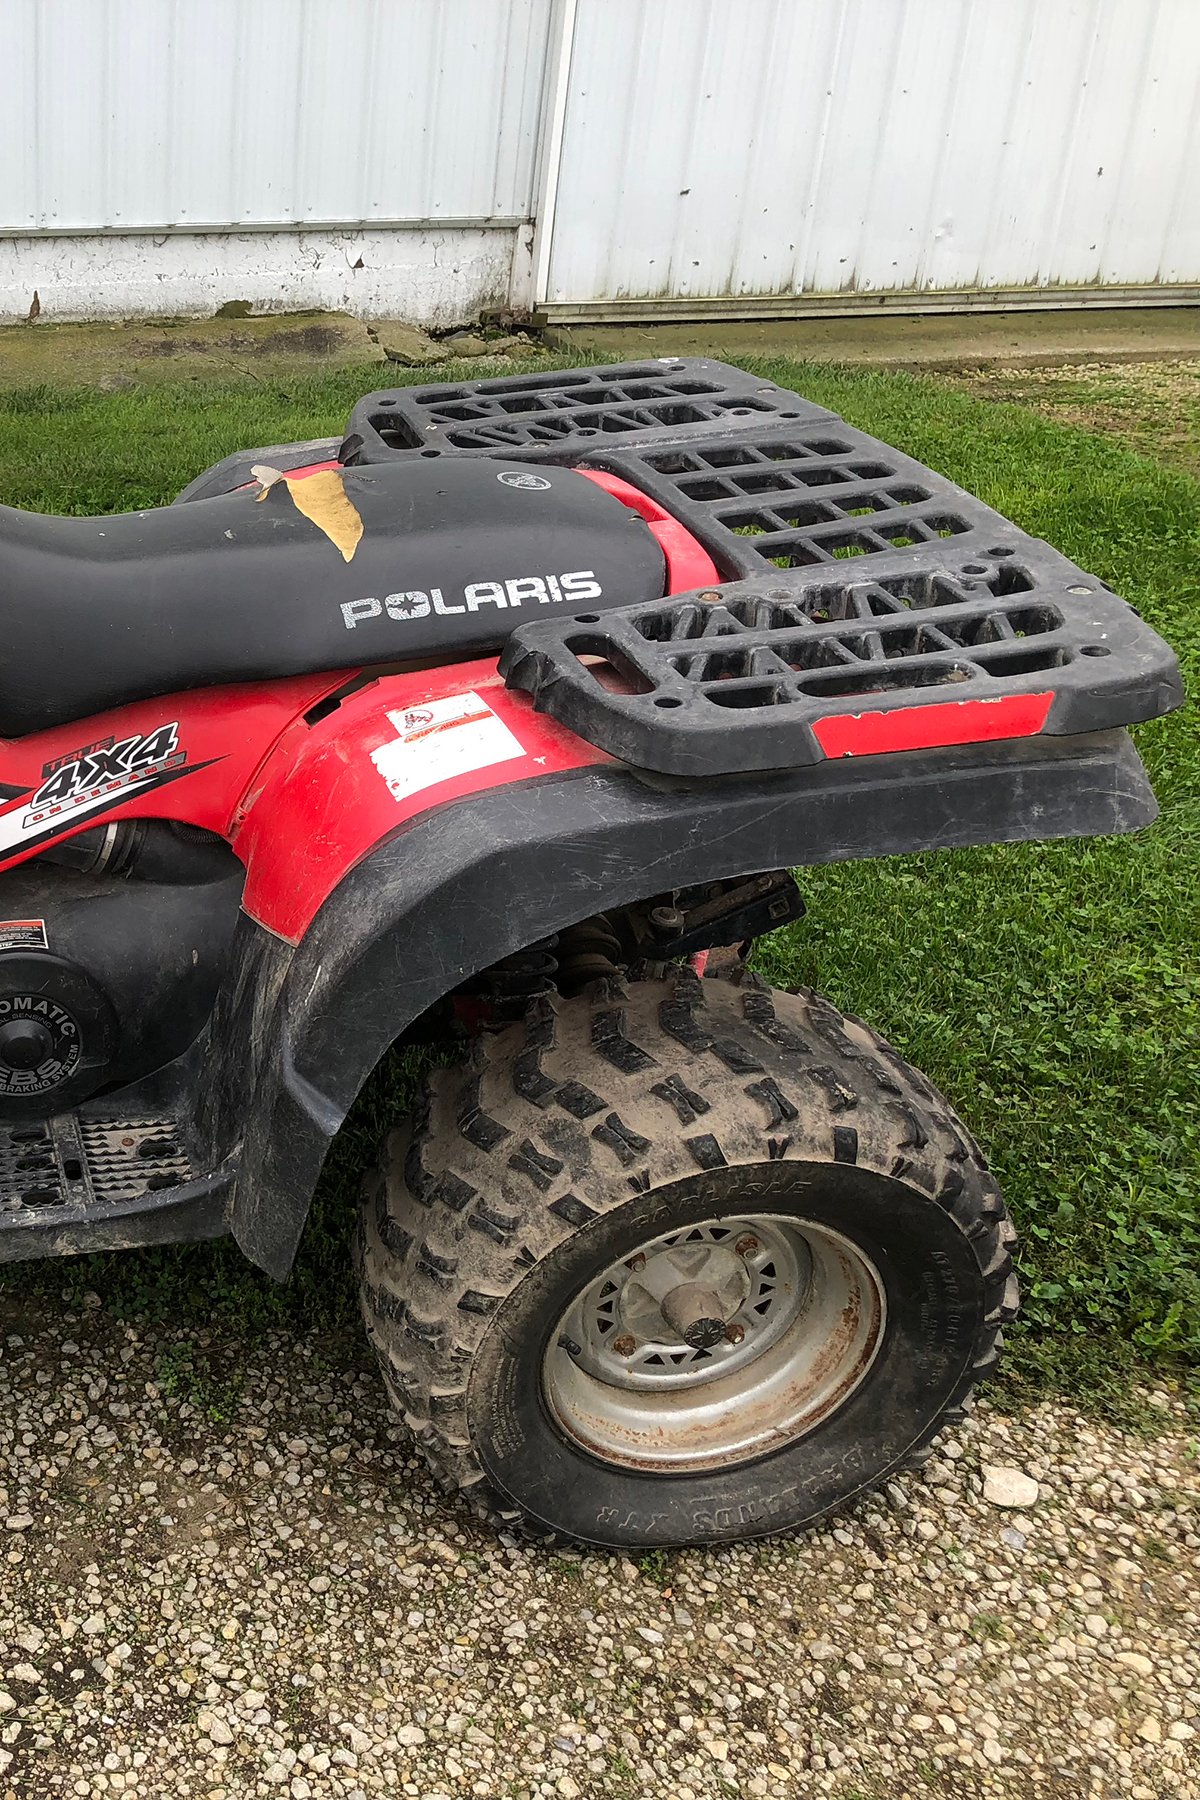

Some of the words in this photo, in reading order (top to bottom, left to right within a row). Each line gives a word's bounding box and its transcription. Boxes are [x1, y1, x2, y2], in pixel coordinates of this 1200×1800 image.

[340, 570, 603, 630] POLARIS
[32, 805, 62, 822] ON
[74, 759, 176, 804] DEMAND
[11, 1012, 53, 1029] SENSING
[51, 1044, 79, 1082] SYSTEM
